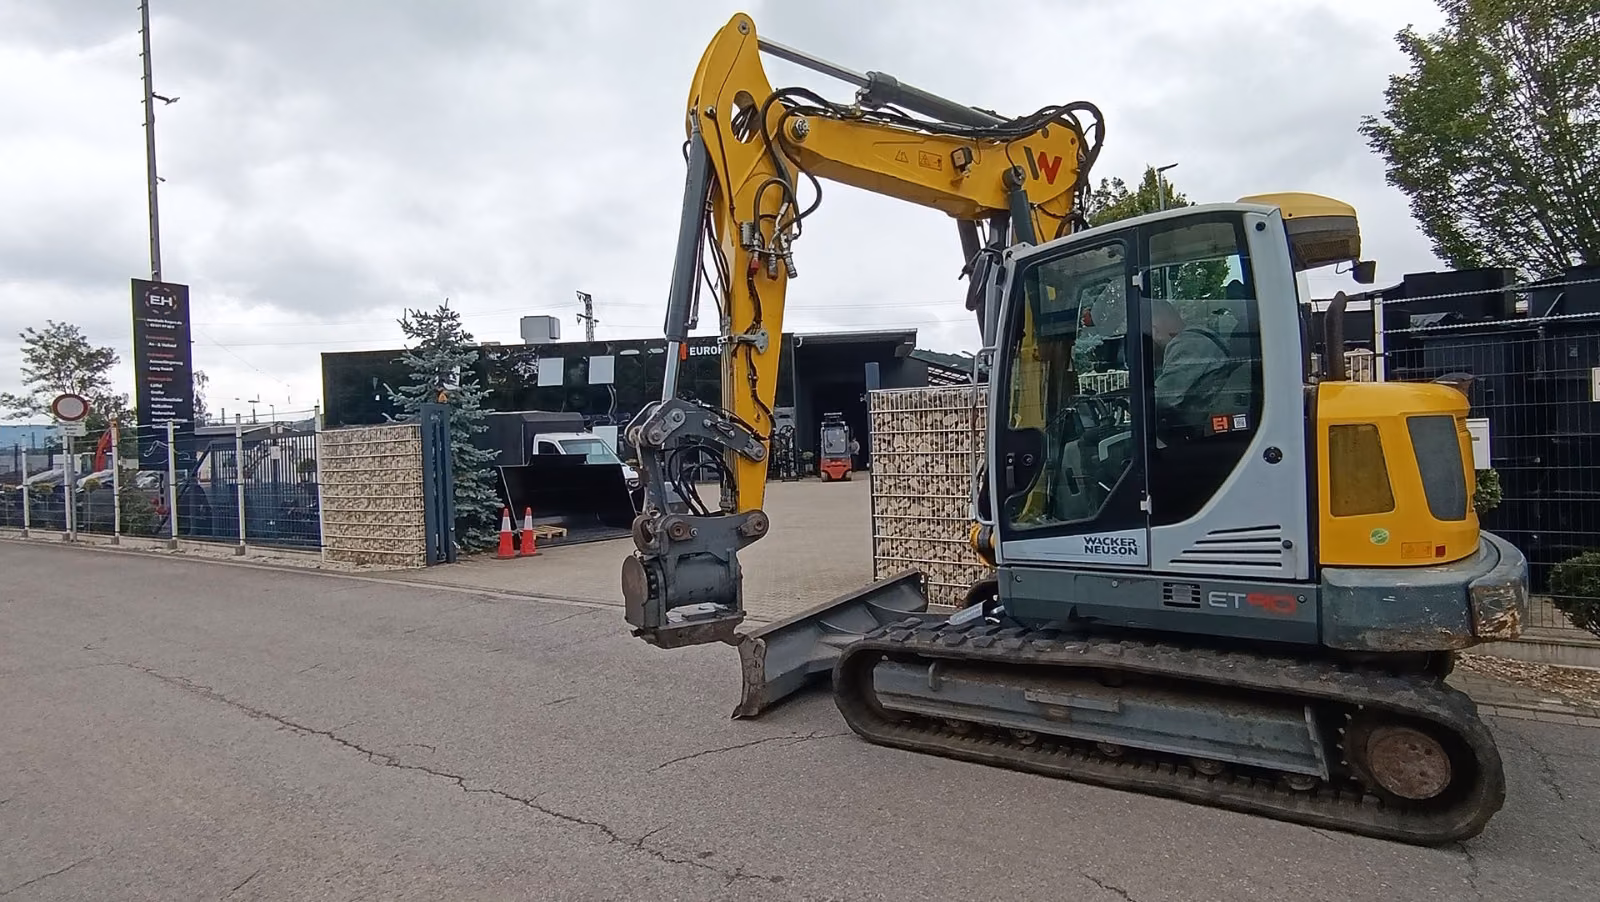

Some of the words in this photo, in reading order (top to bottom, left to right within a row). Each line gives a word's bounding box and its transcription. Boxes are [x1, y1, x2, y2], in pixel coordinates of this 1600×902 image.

[150, 295, 172, 306] EH
[1084, 536, 1137, 546] WACKER
[1085, 545, 1138, 555] NEUSON
[1208, 591, 1297, 614] ET90
